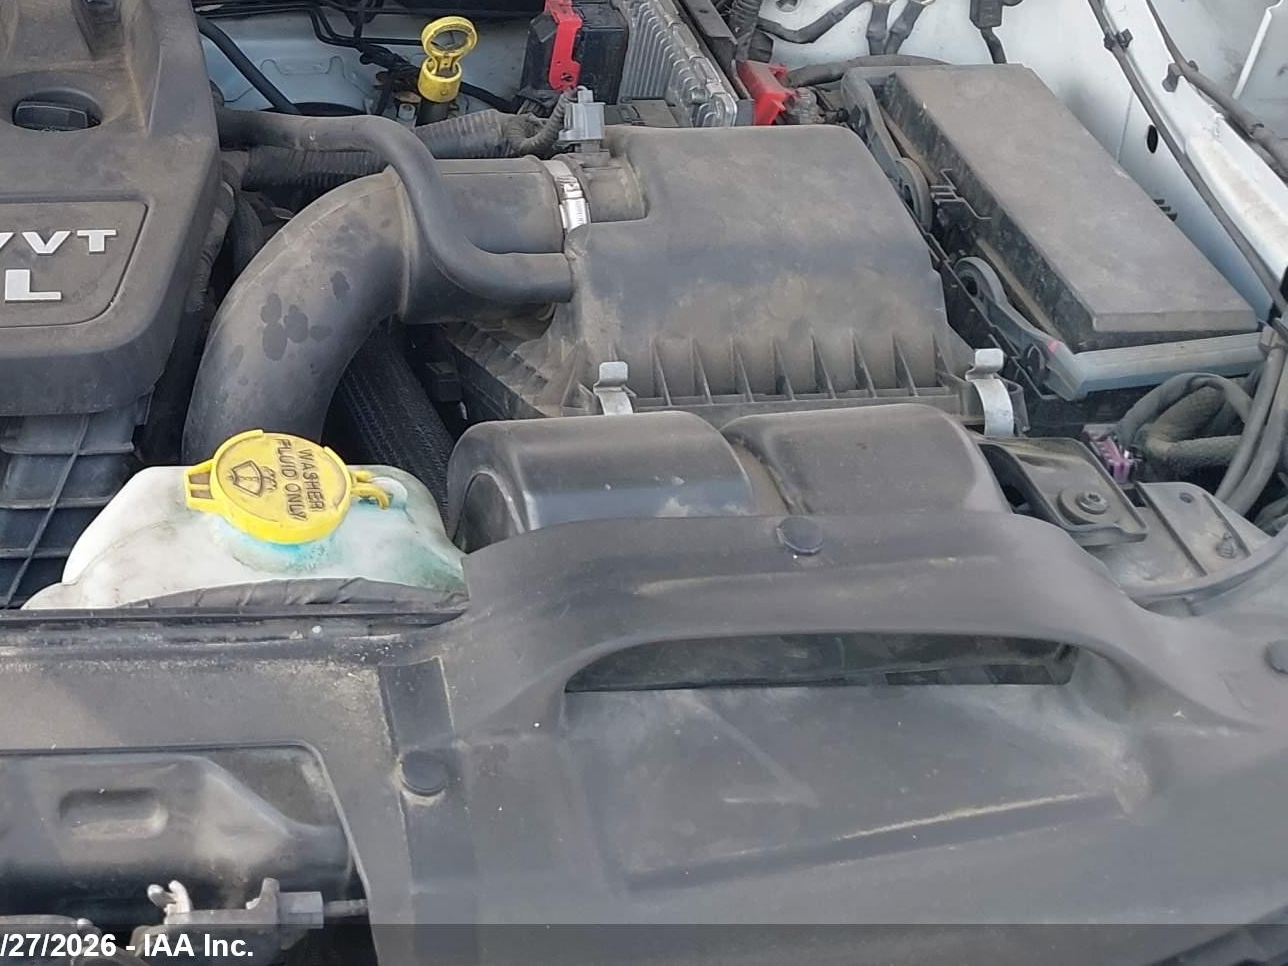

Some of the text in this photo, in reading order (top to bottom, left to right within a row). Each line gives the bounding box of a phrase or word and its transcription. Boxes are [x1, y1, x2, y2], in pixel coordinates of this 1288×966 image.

[4, 269, 62, 303] L
[274, 438, 307, 521] FLUID ONLY
[298, 449, 325, 510] WASHER
